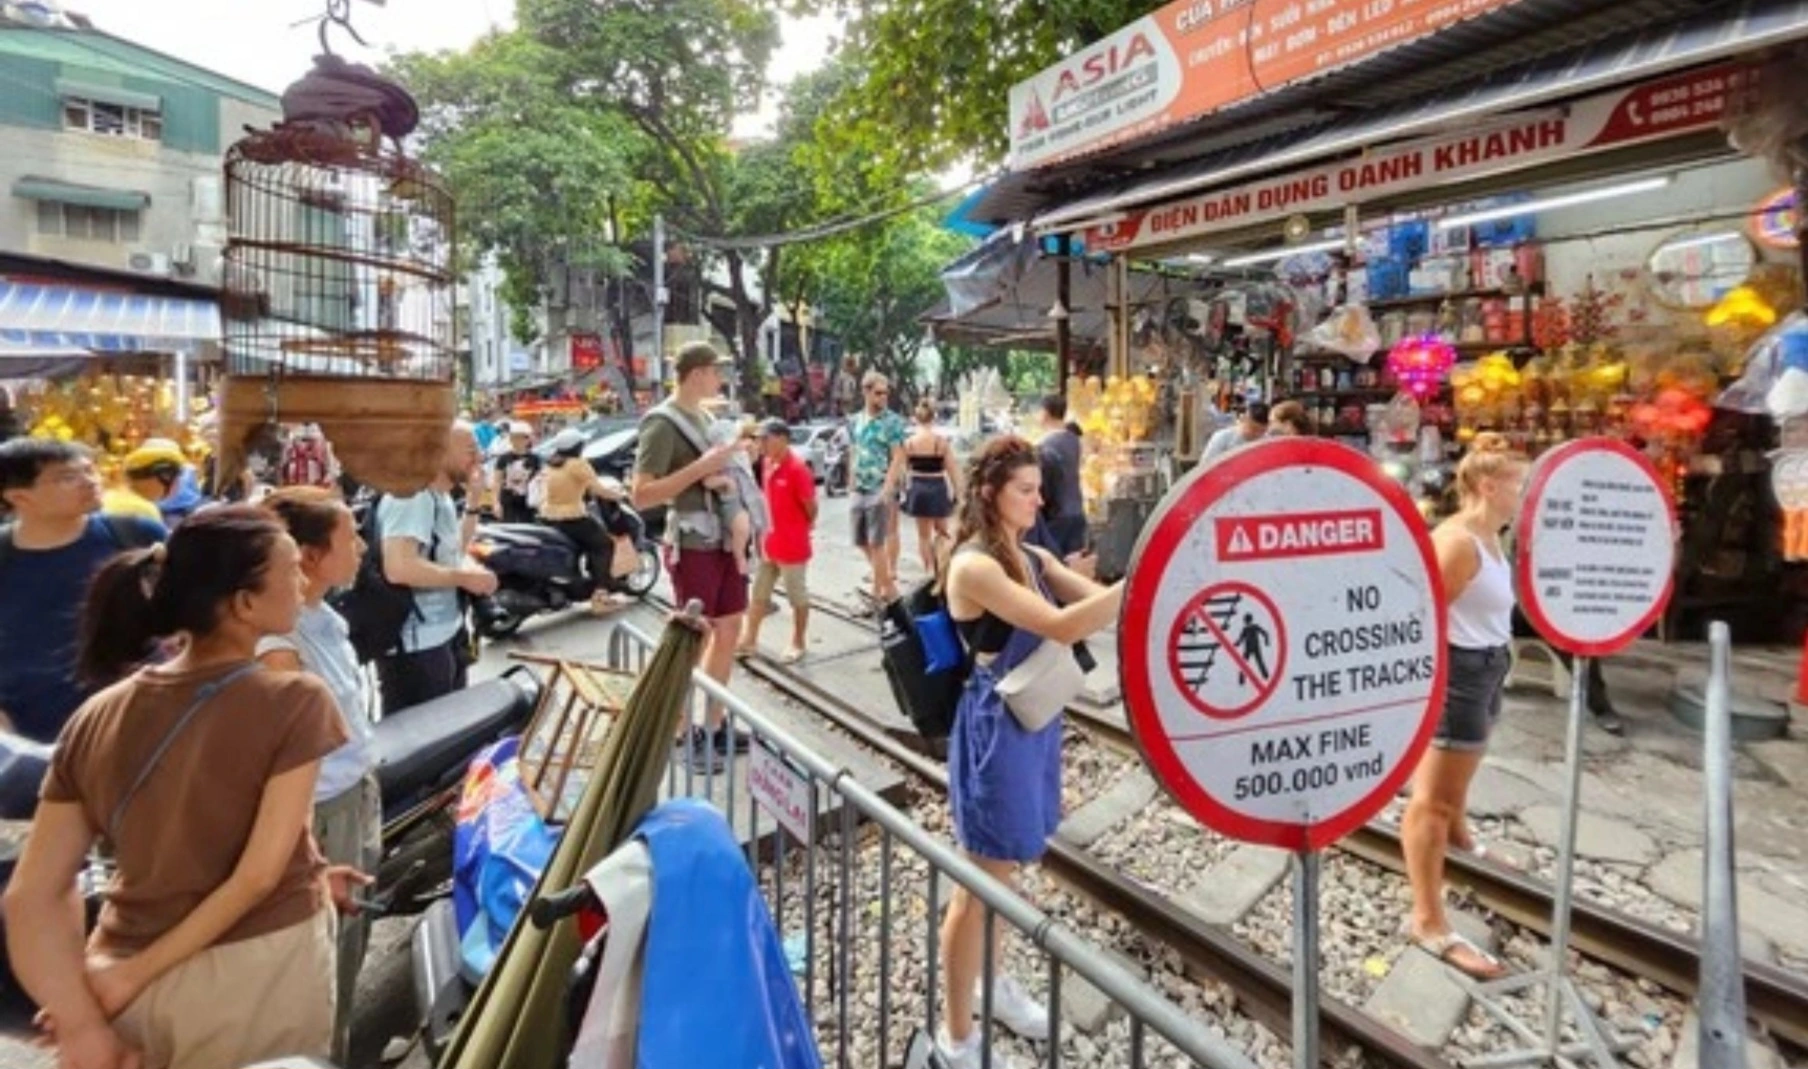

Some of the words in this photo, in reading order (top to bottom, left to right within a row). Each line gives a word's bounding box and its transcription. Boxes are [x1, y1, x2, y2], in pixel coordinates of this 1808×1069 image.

[1052, 32, 1156, 100] ASIA
[1339, 151, 1423, 192] OANH
[1434, 120, 1565, 171] KHANH
[1258, 518, 1374, 551] DANGER
[1347, 586, 1381, 613] NO
[1305, 618, 1422, 659] CROSSING
[1293, 672, 1341, 701] THE
[1349, 656, 1434, 693] TRACKS
[1251, 734, 1314, 766] MAX
[1321, 724, 1371, 755] FINE
[1234, 762, 1338, 801] 500.000
[1345, 752, 1384, 780] vnd
